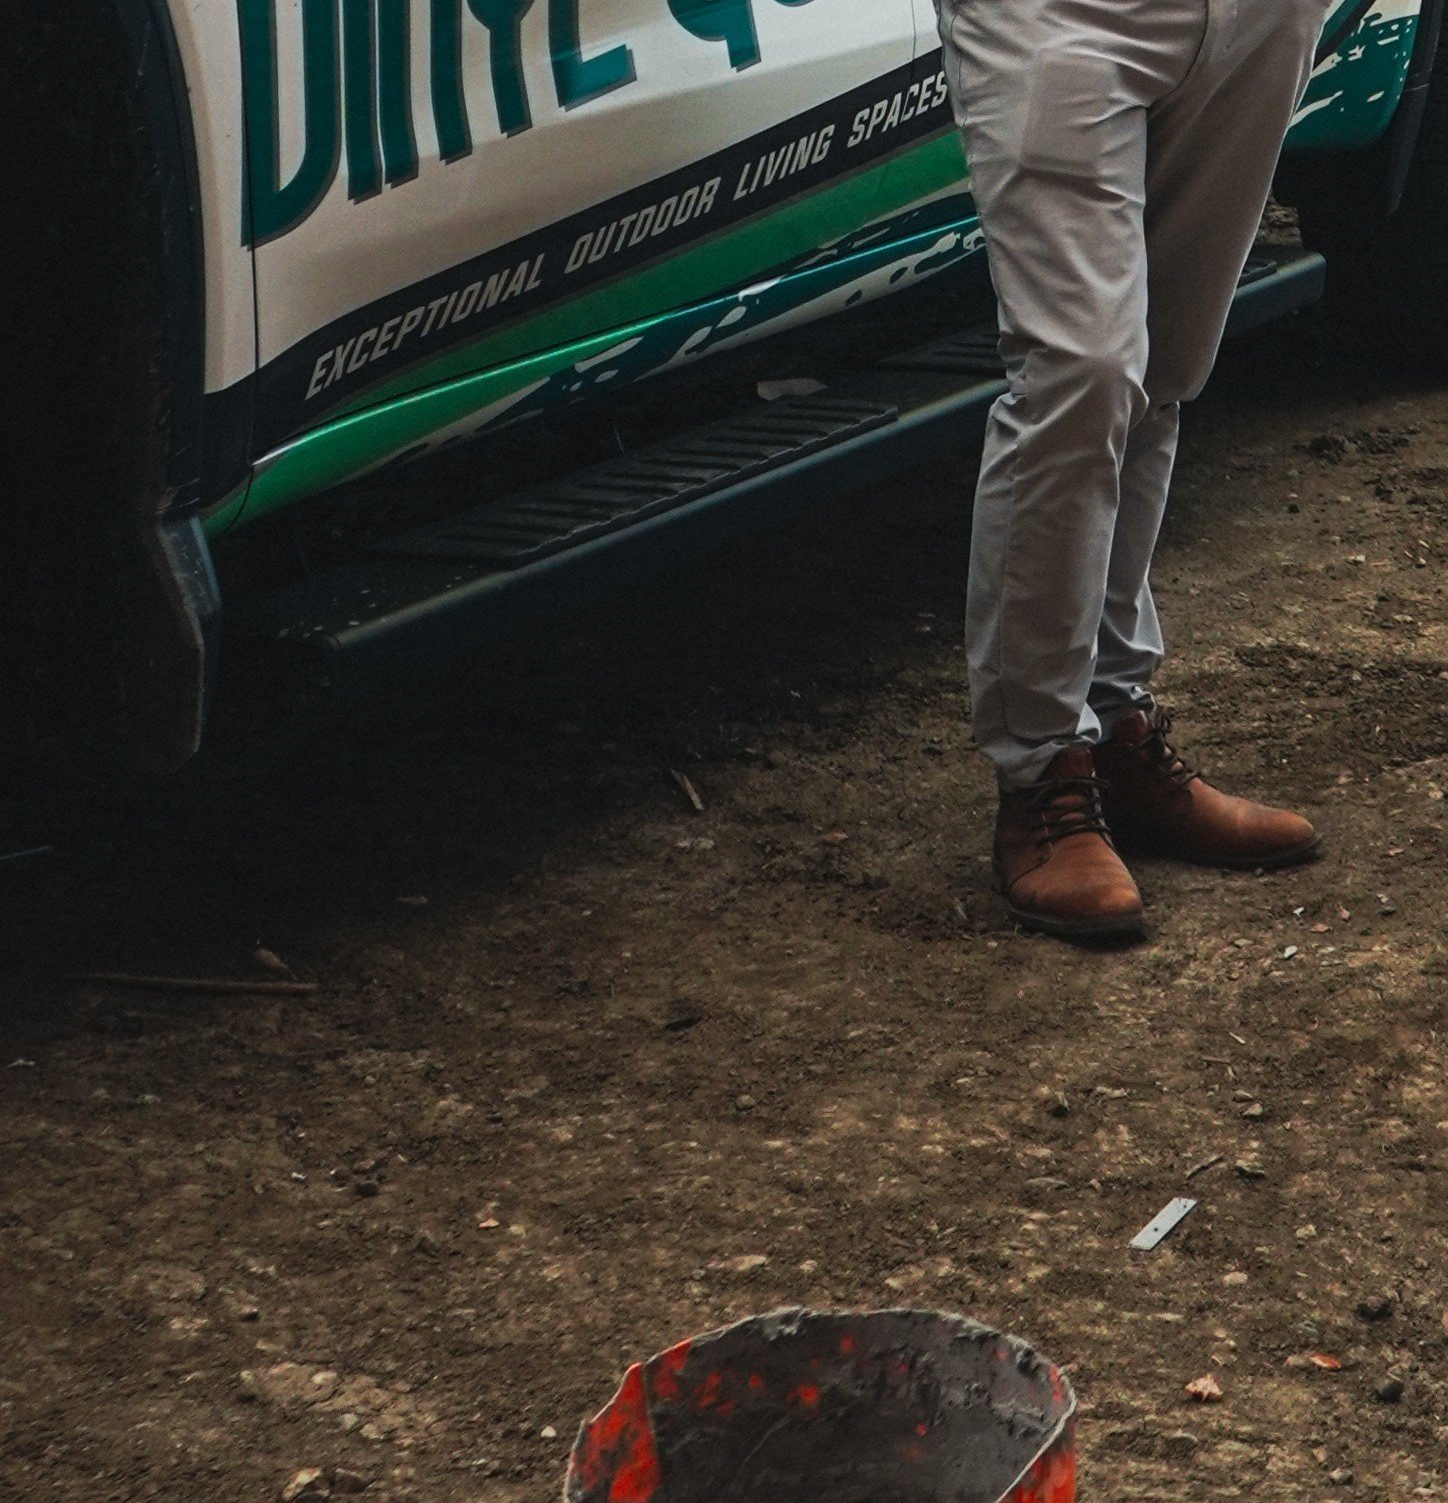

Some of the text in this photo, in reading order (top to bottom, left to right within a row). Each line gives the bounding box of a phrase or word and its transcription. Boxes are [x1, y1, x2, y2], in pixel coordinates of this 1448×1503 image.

[305, 70, 949, 401] EXCEPTIONAL OUTDOOR LIVING SPACES
